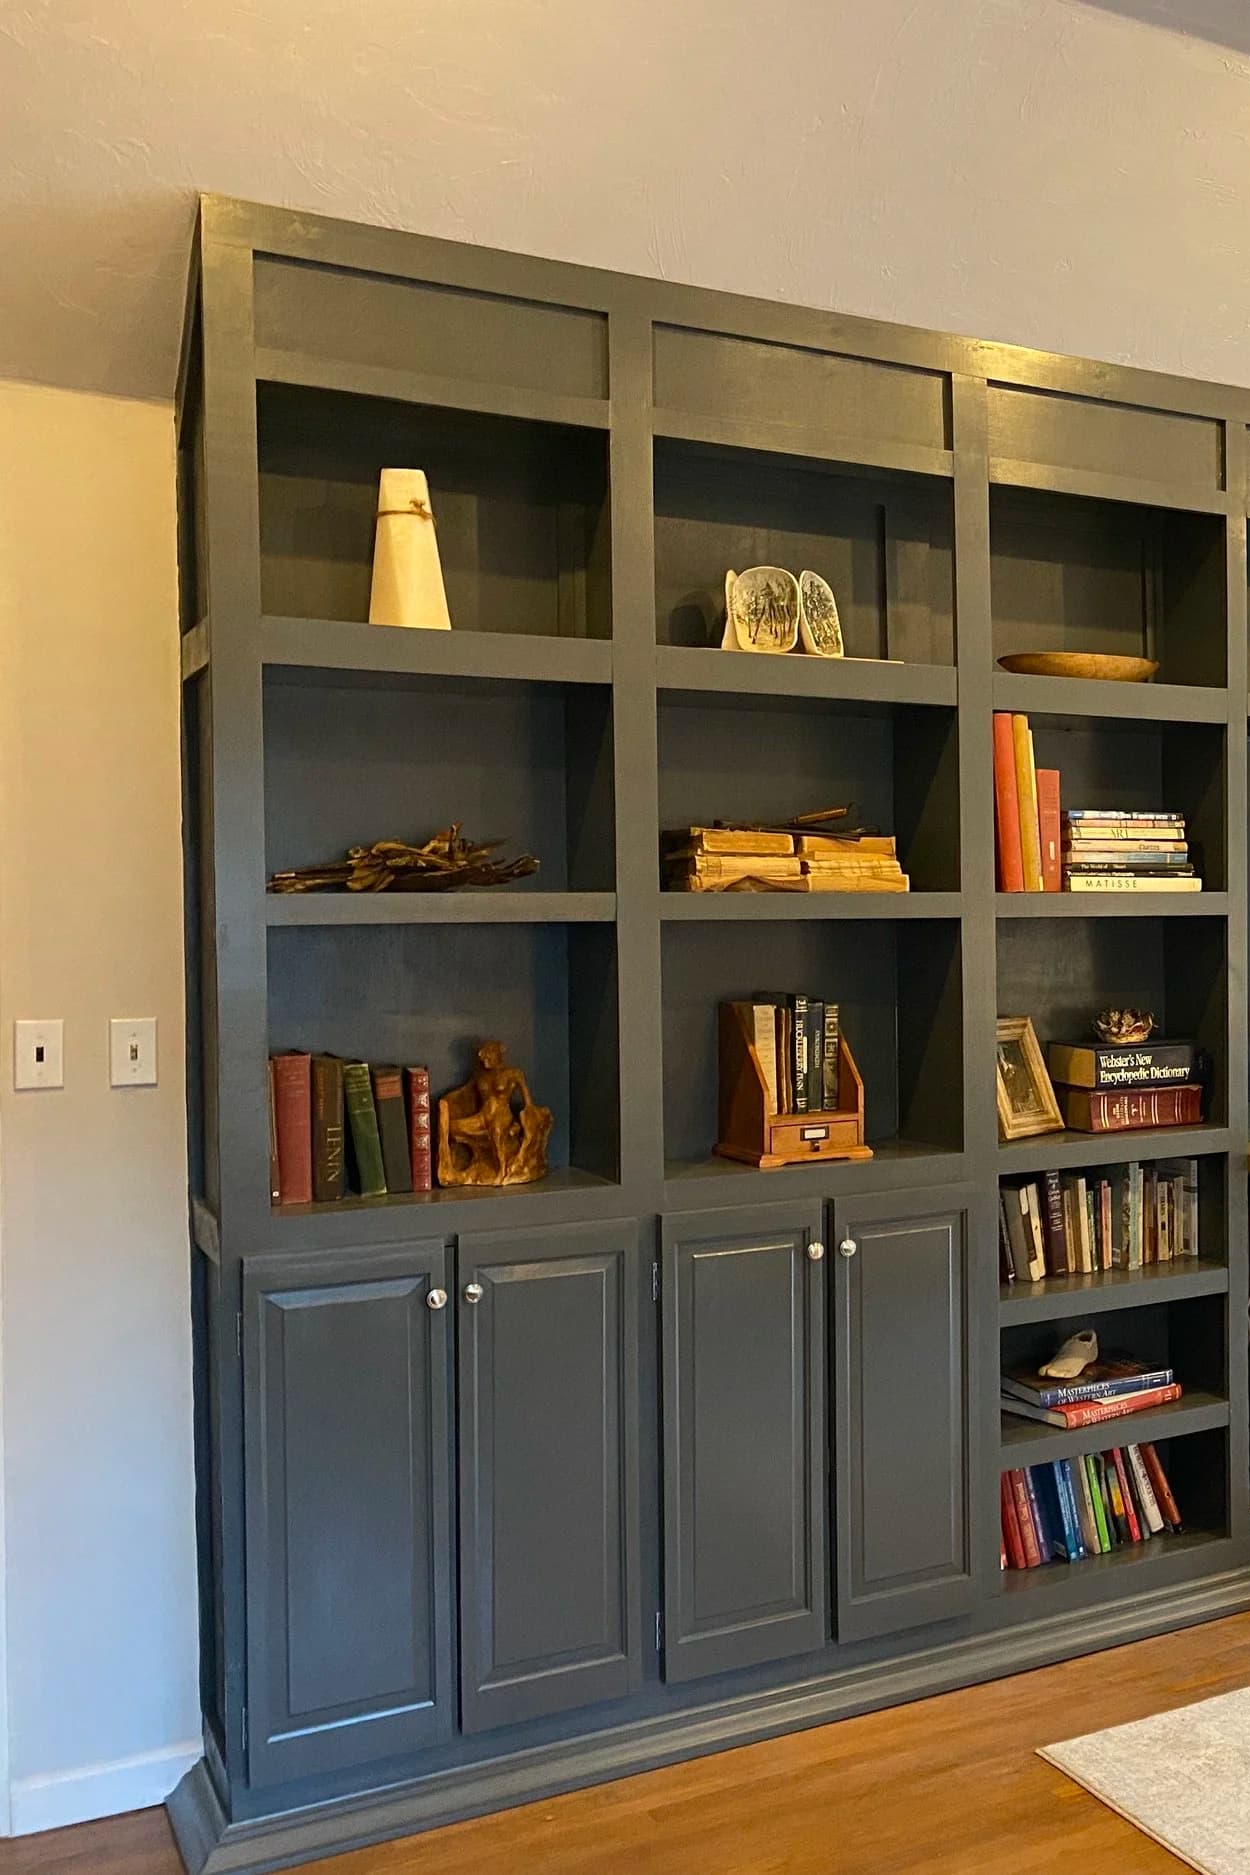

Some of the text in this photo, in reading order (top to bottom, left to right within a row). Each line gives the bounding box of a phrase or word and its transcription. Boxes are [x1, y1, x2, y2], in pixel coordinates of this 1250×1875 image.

[1085, 879, 1138, 889] MATISSE
[1099, 1053, 1153, 1068] Webster's New
[1099, 1066, 1190, 1086] Encyclopedic Dictionary
[326, 1126, 342, 1182] LENIN
[1057, 1383, 1110, 1398] MASTERPIECES
[1103, 1389, 1117, 1398] ART
[1081, 1401, 1128, 1420] MASTERPIECES
